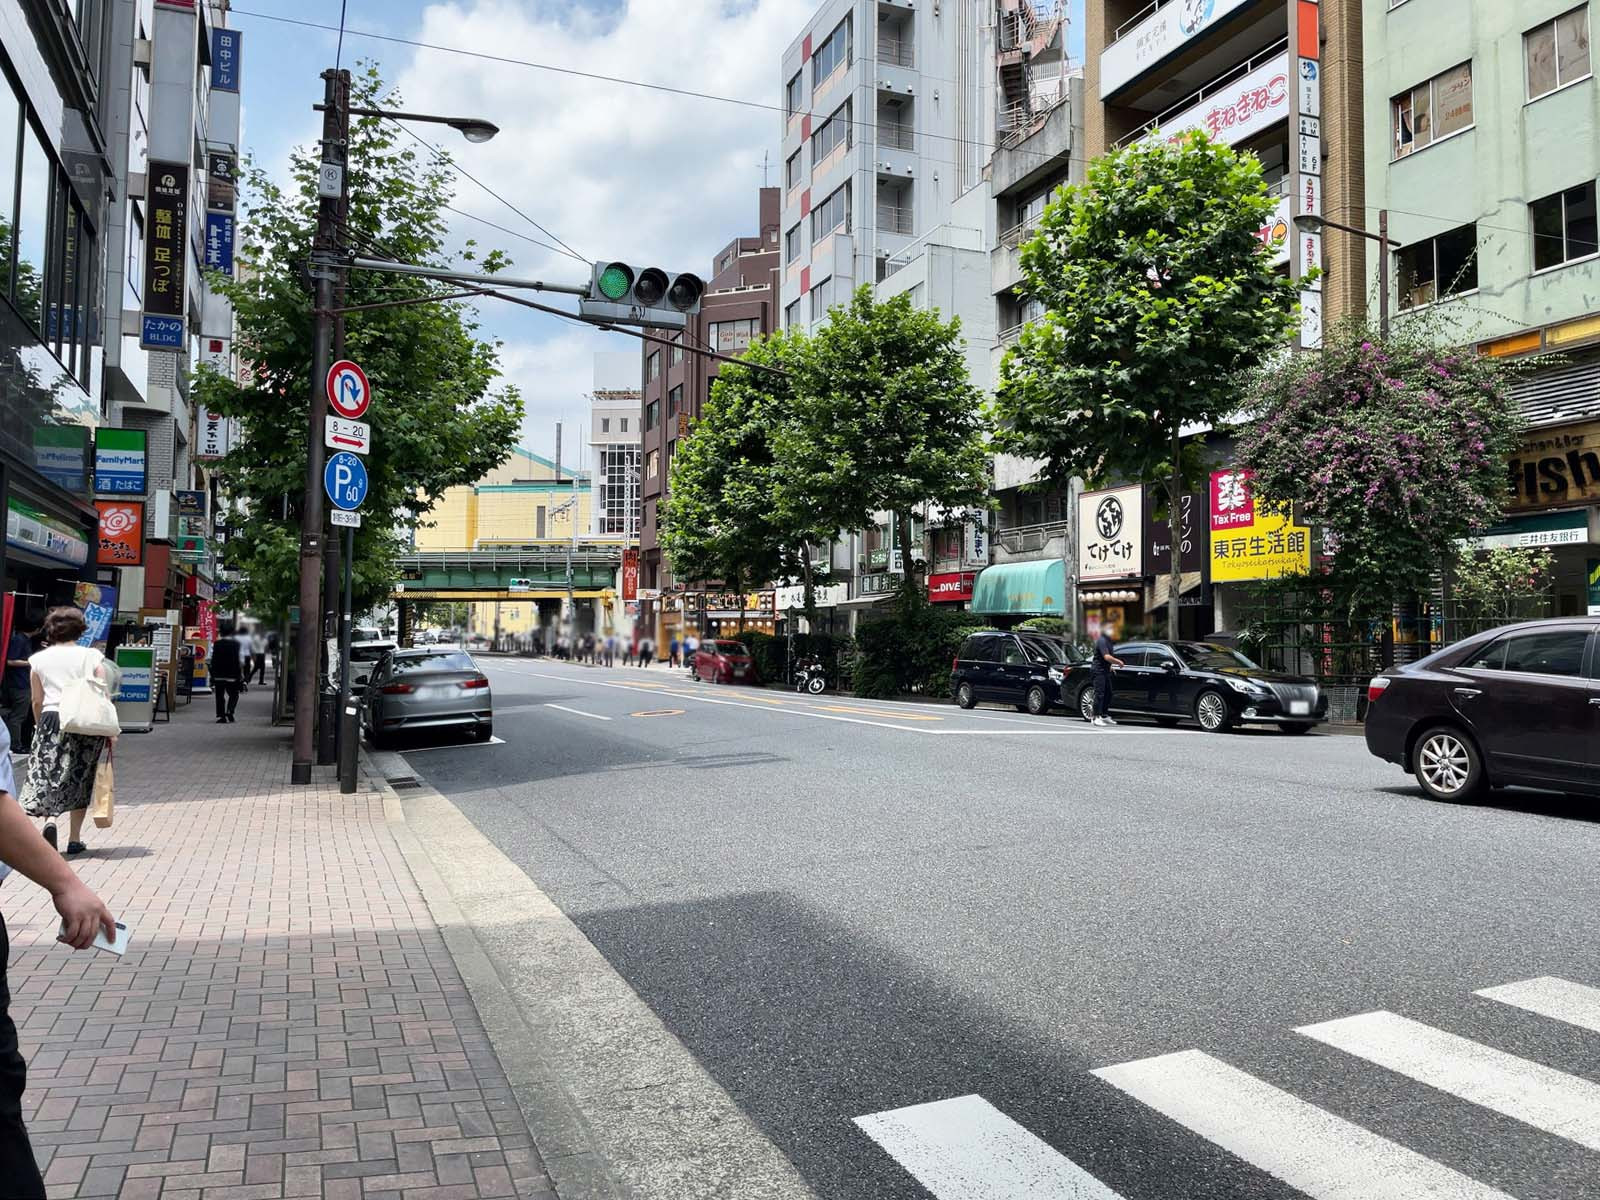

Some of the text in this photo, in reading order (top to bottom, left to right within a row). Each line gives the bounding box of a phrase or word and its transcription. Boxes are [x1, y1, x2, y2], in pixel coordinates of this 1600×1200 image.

[219, 35, 233, 85] 田中ビル
[1206, 74, 1287, 142] まねきねこ
[1306, 186, 1314, 213] カラオ
[156, 209, 173, 240] 整体
[153, 247, 170, 293] 足つぼ
[145, 319, 182, 332] たかの
[149, 333, 176, 342] BLDG
[333, 421, 339, 432] 8
[352, 425, 364, 438] 20
[205, 422, 219, 455] 天下一品
[96, 455, 145, 464] FamilyMart
[338, 454, 357, 466] 8-20
[98, 478, 142, 490] 酒 たばこ
[335, 463, 352, 500] P
[1218, 473, 1247, 512] 薬
[1180, 495, 1192, 554] ワインの
[1213, 512, 1252, 526] Tax Free
[1213, 531, 1306, 560] 東京生活館
[1519, 530, 1580, 546] 三井住友銀行
[112, 550, 137, 560] うどん
[1087, 540, 1134, 563] てけてけ
[624, 566, 637, 578] 29
[940, 581, 961, 592] DIVE
[120, 672, 149, 680] amilyMart
